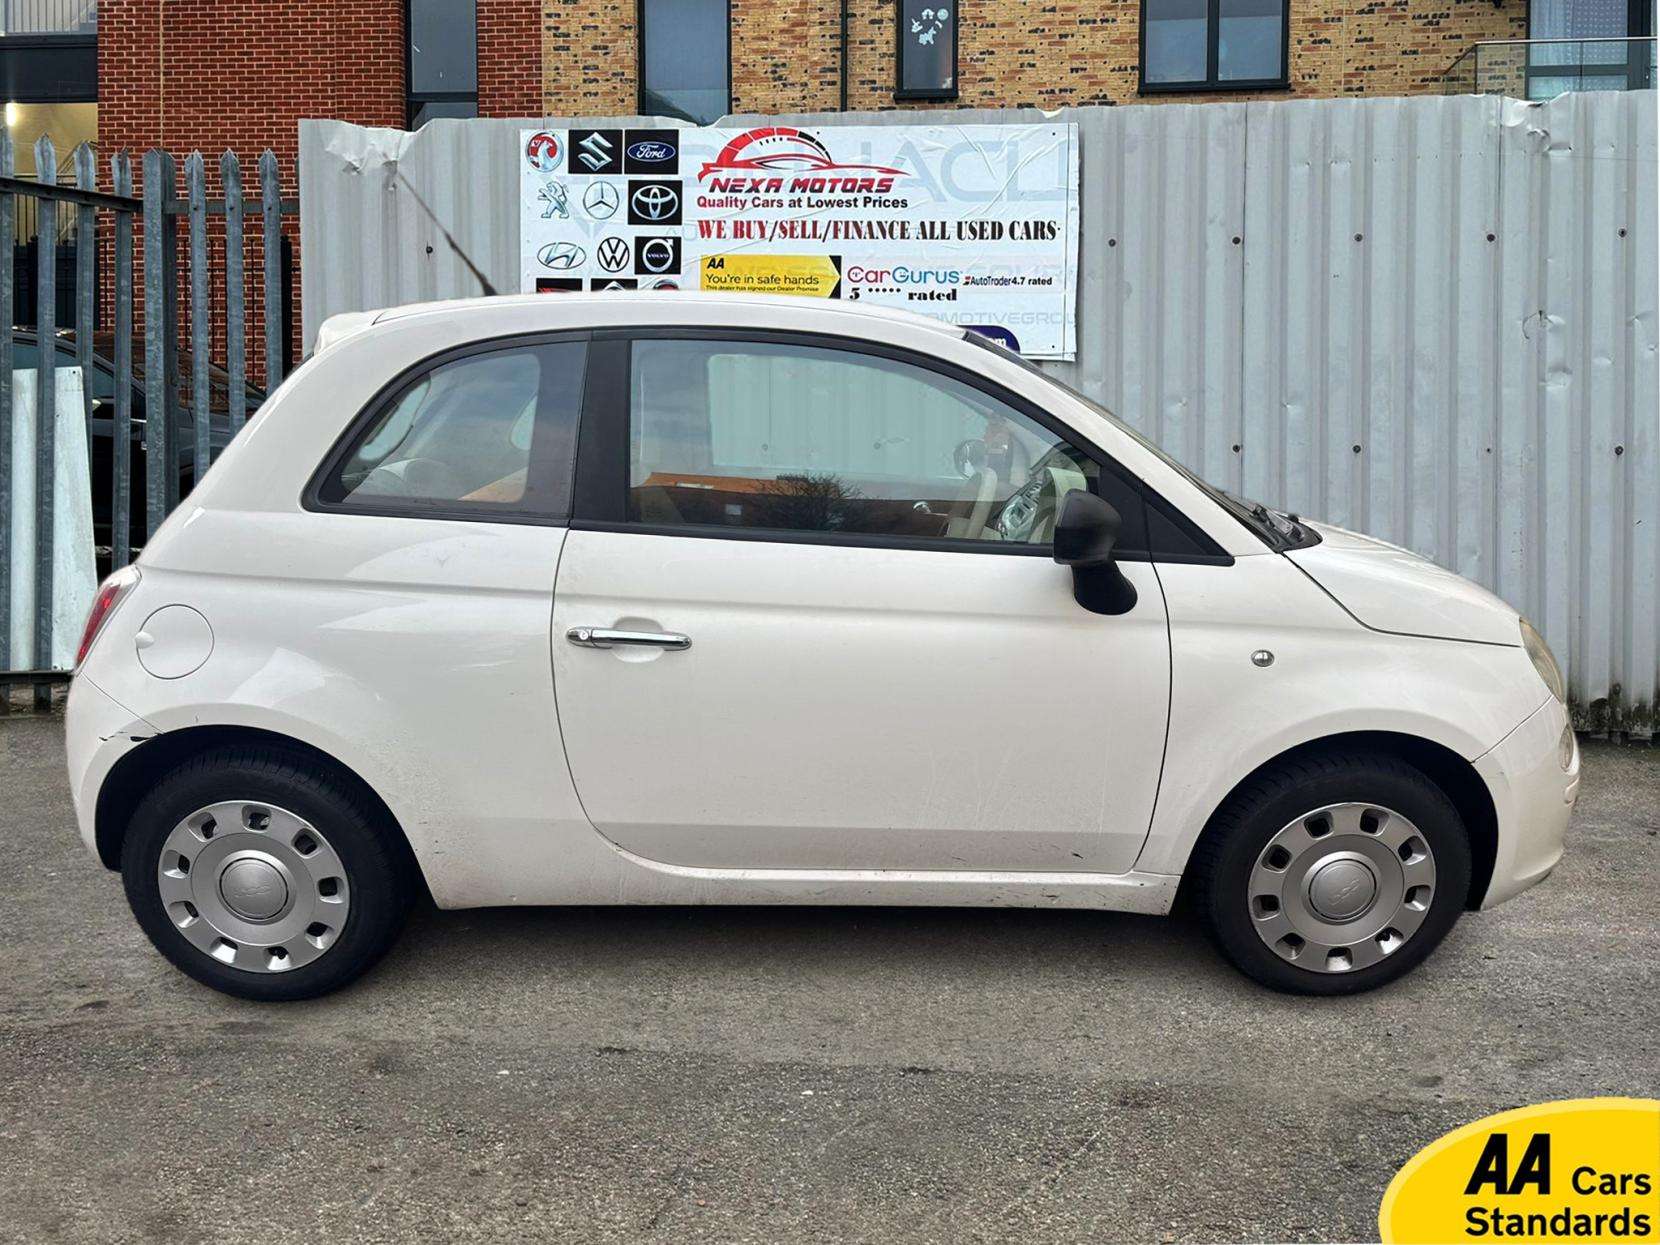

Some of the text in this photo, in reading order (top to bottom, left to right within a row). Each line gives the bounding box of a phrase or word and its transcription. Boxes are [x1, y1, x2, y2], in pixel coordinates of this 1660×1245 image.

[636, 144, 666, 159] Ford
[709, 177, 895, 193] NEXA MOTORS
[697, 195, 909, 210] Quality Cars at Lowest Prices
[698, 220, 727, 240] WE
[916, 220, 950, 240] ALL
[957, 220, 1004, 240] USED
[1009, 220, 1057, 241] CARS
[646, 252, 670, 260] VOLVO
[707, 257, 725, 269] AA
[705, 273, 820, 286] You're in safe hands
[847, 266, 960, 284] CarGurus
[1028, 277, 1053, 286] rated
[849, 287, 958, 301] 5 rated
